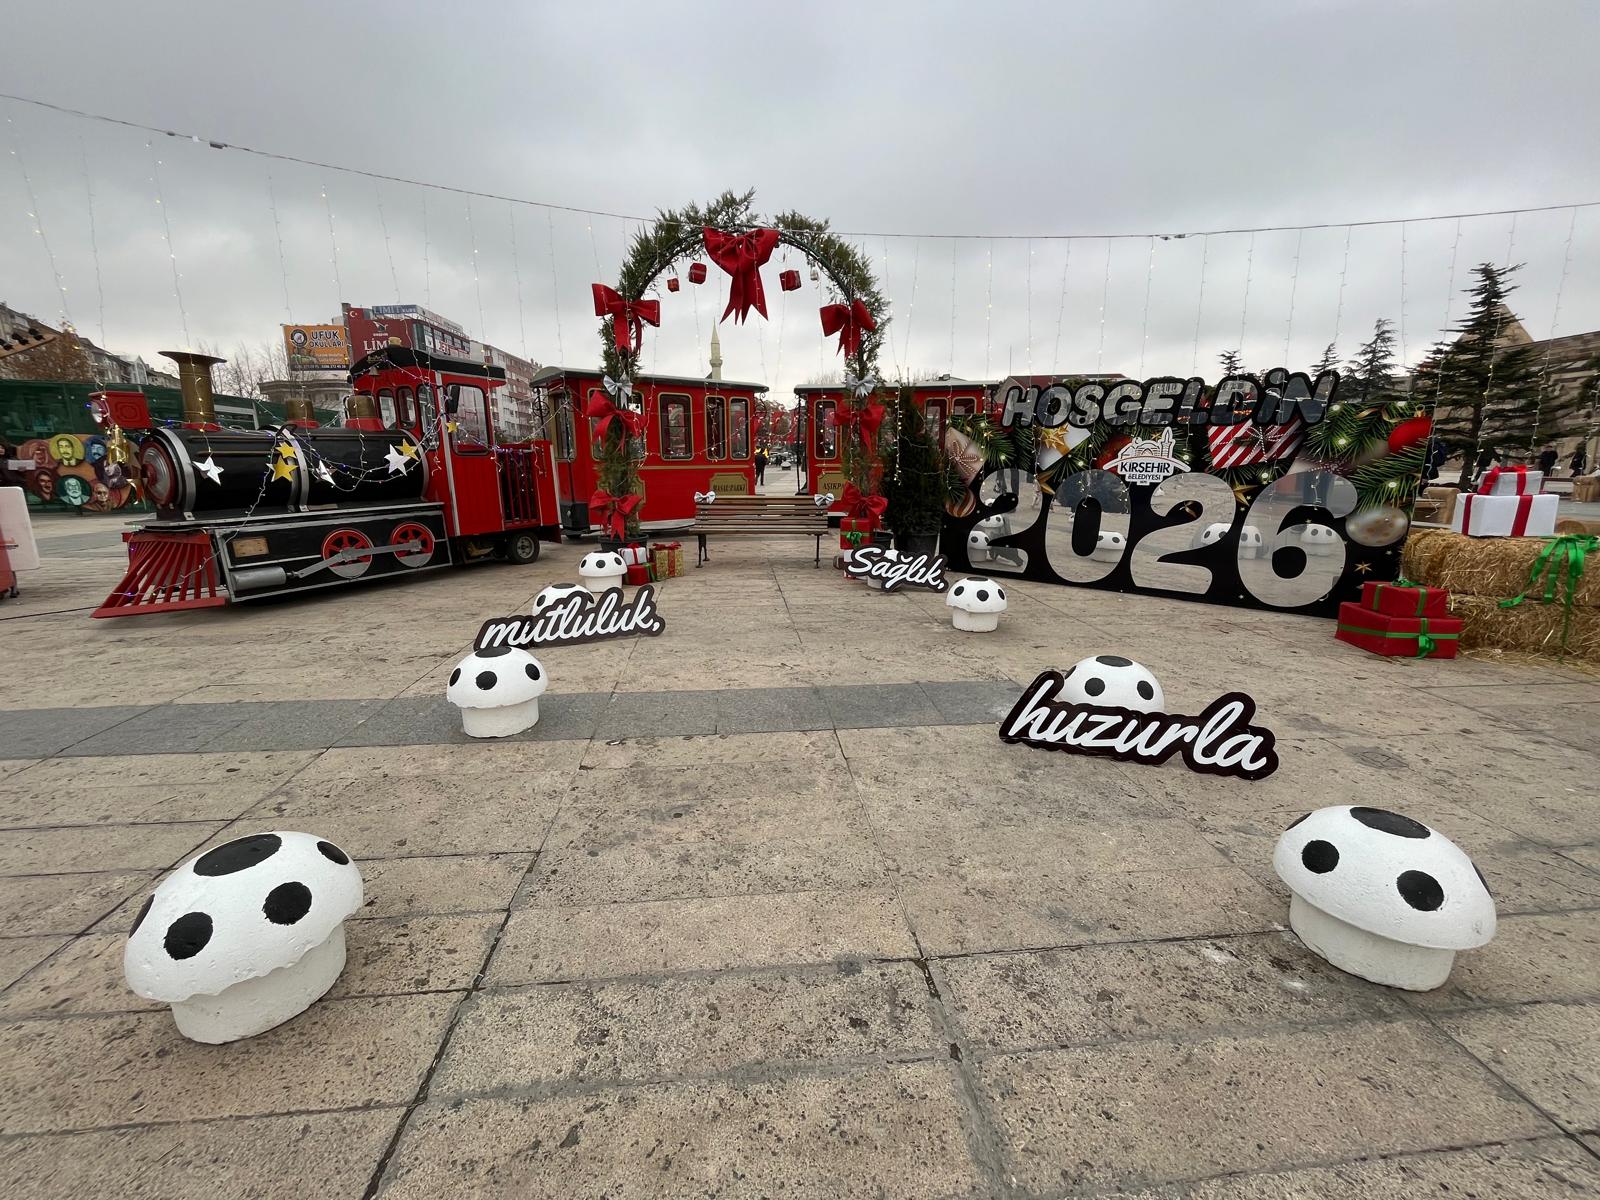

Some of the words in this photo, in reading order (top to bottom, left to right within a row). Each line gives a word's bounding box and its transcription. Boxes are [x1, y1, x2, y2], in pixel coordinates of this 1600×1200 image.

[311, 330, 339, 340] UFUK
[967, 468, 1358, 608] 2026
[480, 589, 661, 649] mutluluk,
[1008, 679, 1267, 771] huzurla
